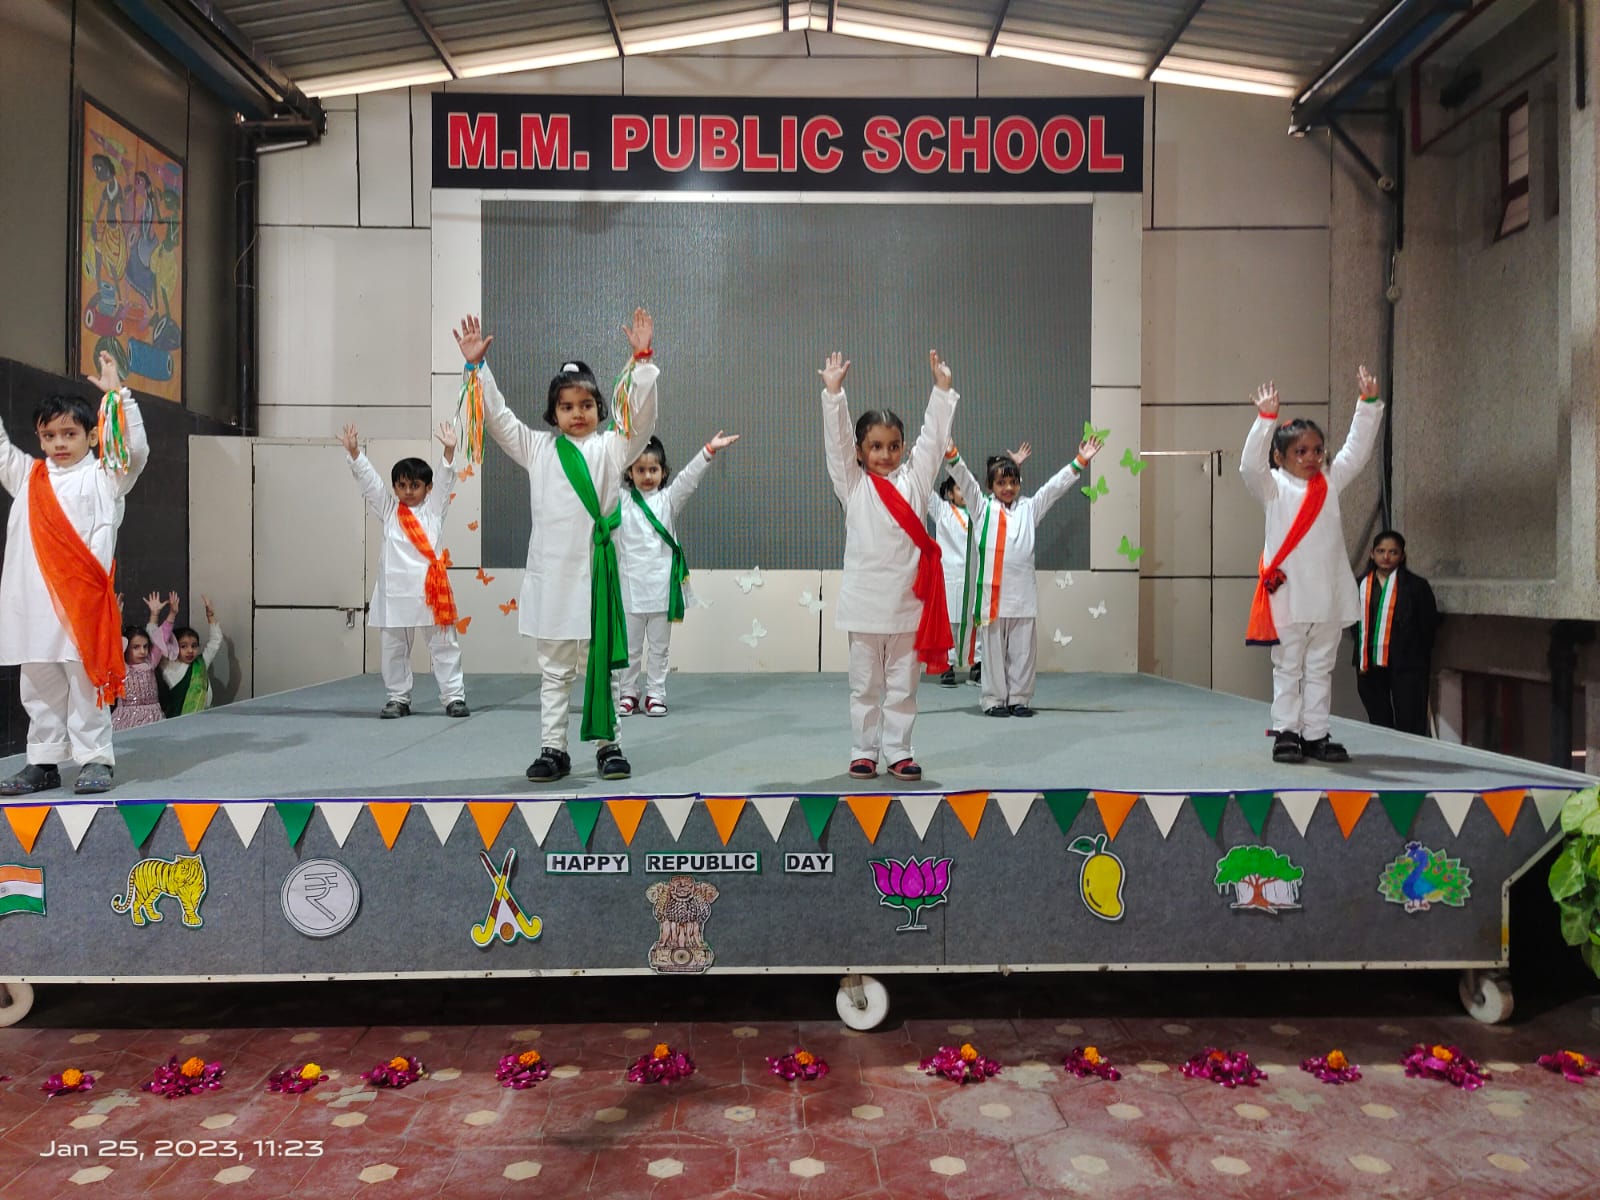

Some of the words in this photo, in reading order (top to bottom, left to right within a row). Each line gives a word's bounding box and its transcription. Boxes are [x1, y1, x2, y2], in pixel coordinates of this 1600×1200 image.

[447, 111, 591, 171] M.M.
[611, 113, 844, 174] PUBLIC
[862, 114, 1125, 174] SCHOOL
[552, 855, 627, 871] HAPPY
[647, 854, 756, 871] REPUBLIC
[786, 855, 831, 871] DAY
